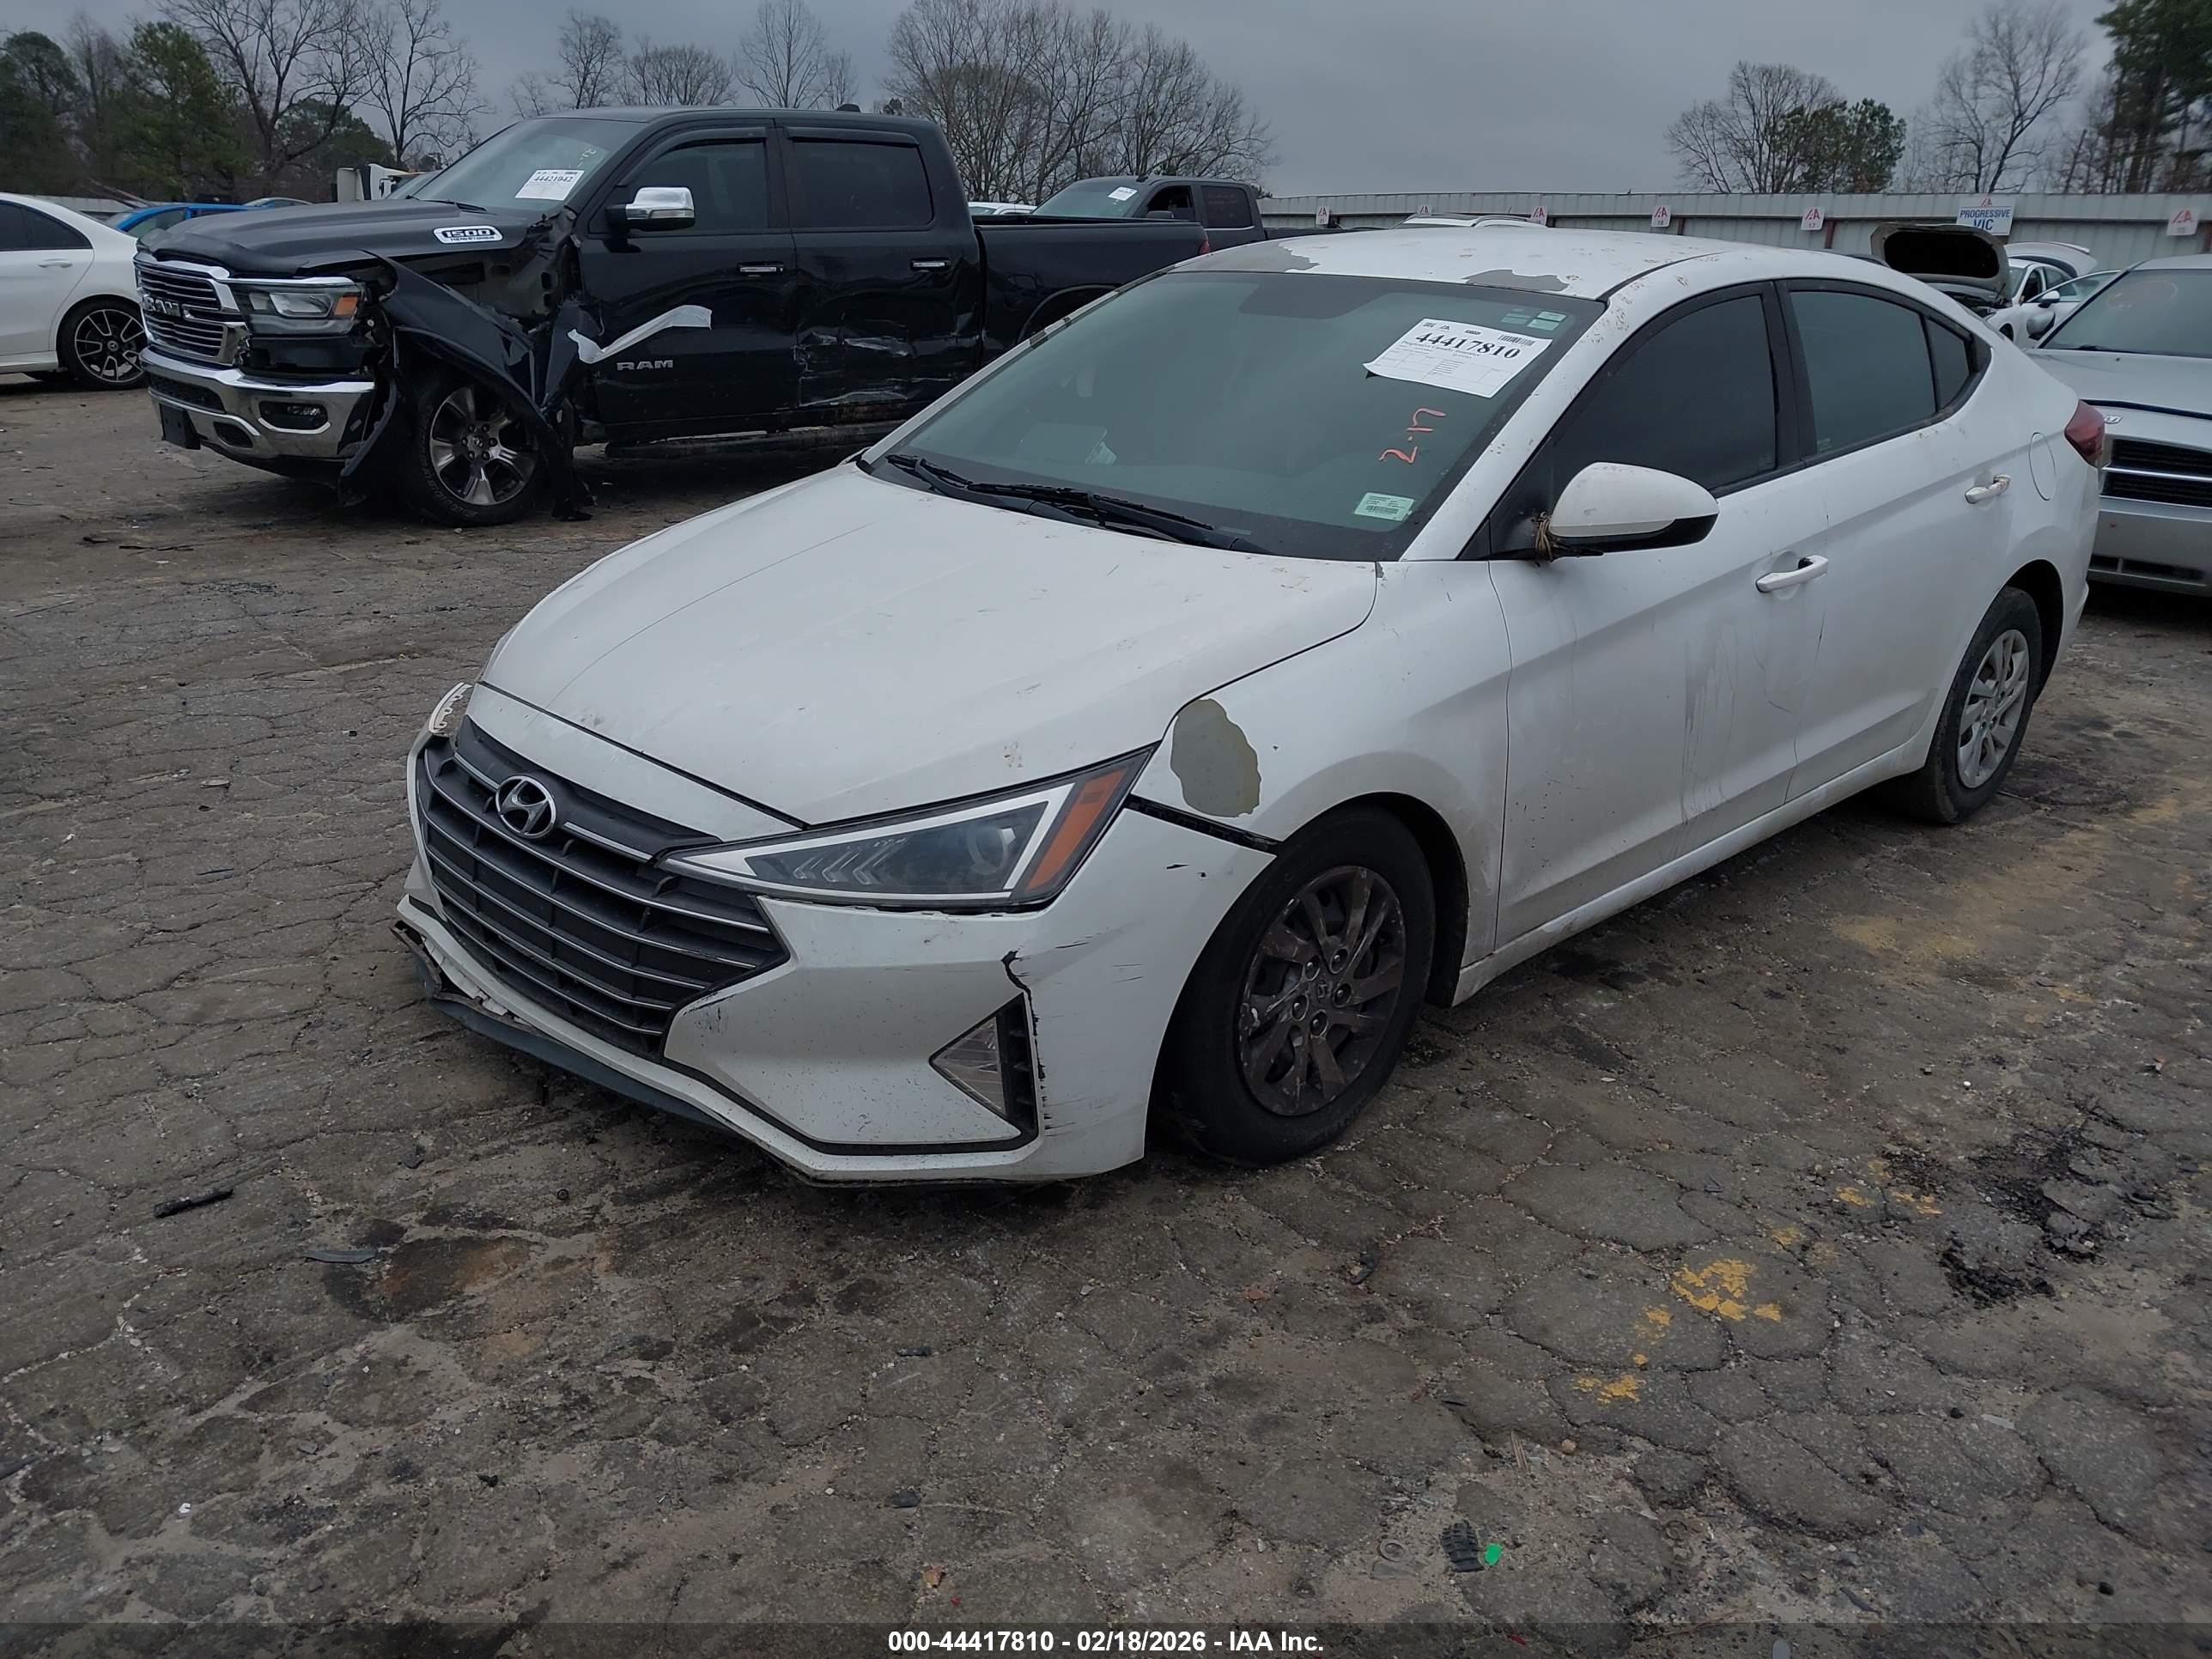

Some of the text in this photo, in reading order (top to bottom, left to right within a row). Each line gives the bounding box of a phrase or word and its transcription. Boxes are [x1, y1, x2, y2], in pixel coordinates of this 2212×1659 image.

[1960, 209, 2011, 218] PROGRESSIVE
[1973, 218, 1994, 230] VIC
[445, 228, 491, 239] 1500
[1415, 332, 1521, 359] 44417810
[617, 360, 673, 371] RAM
